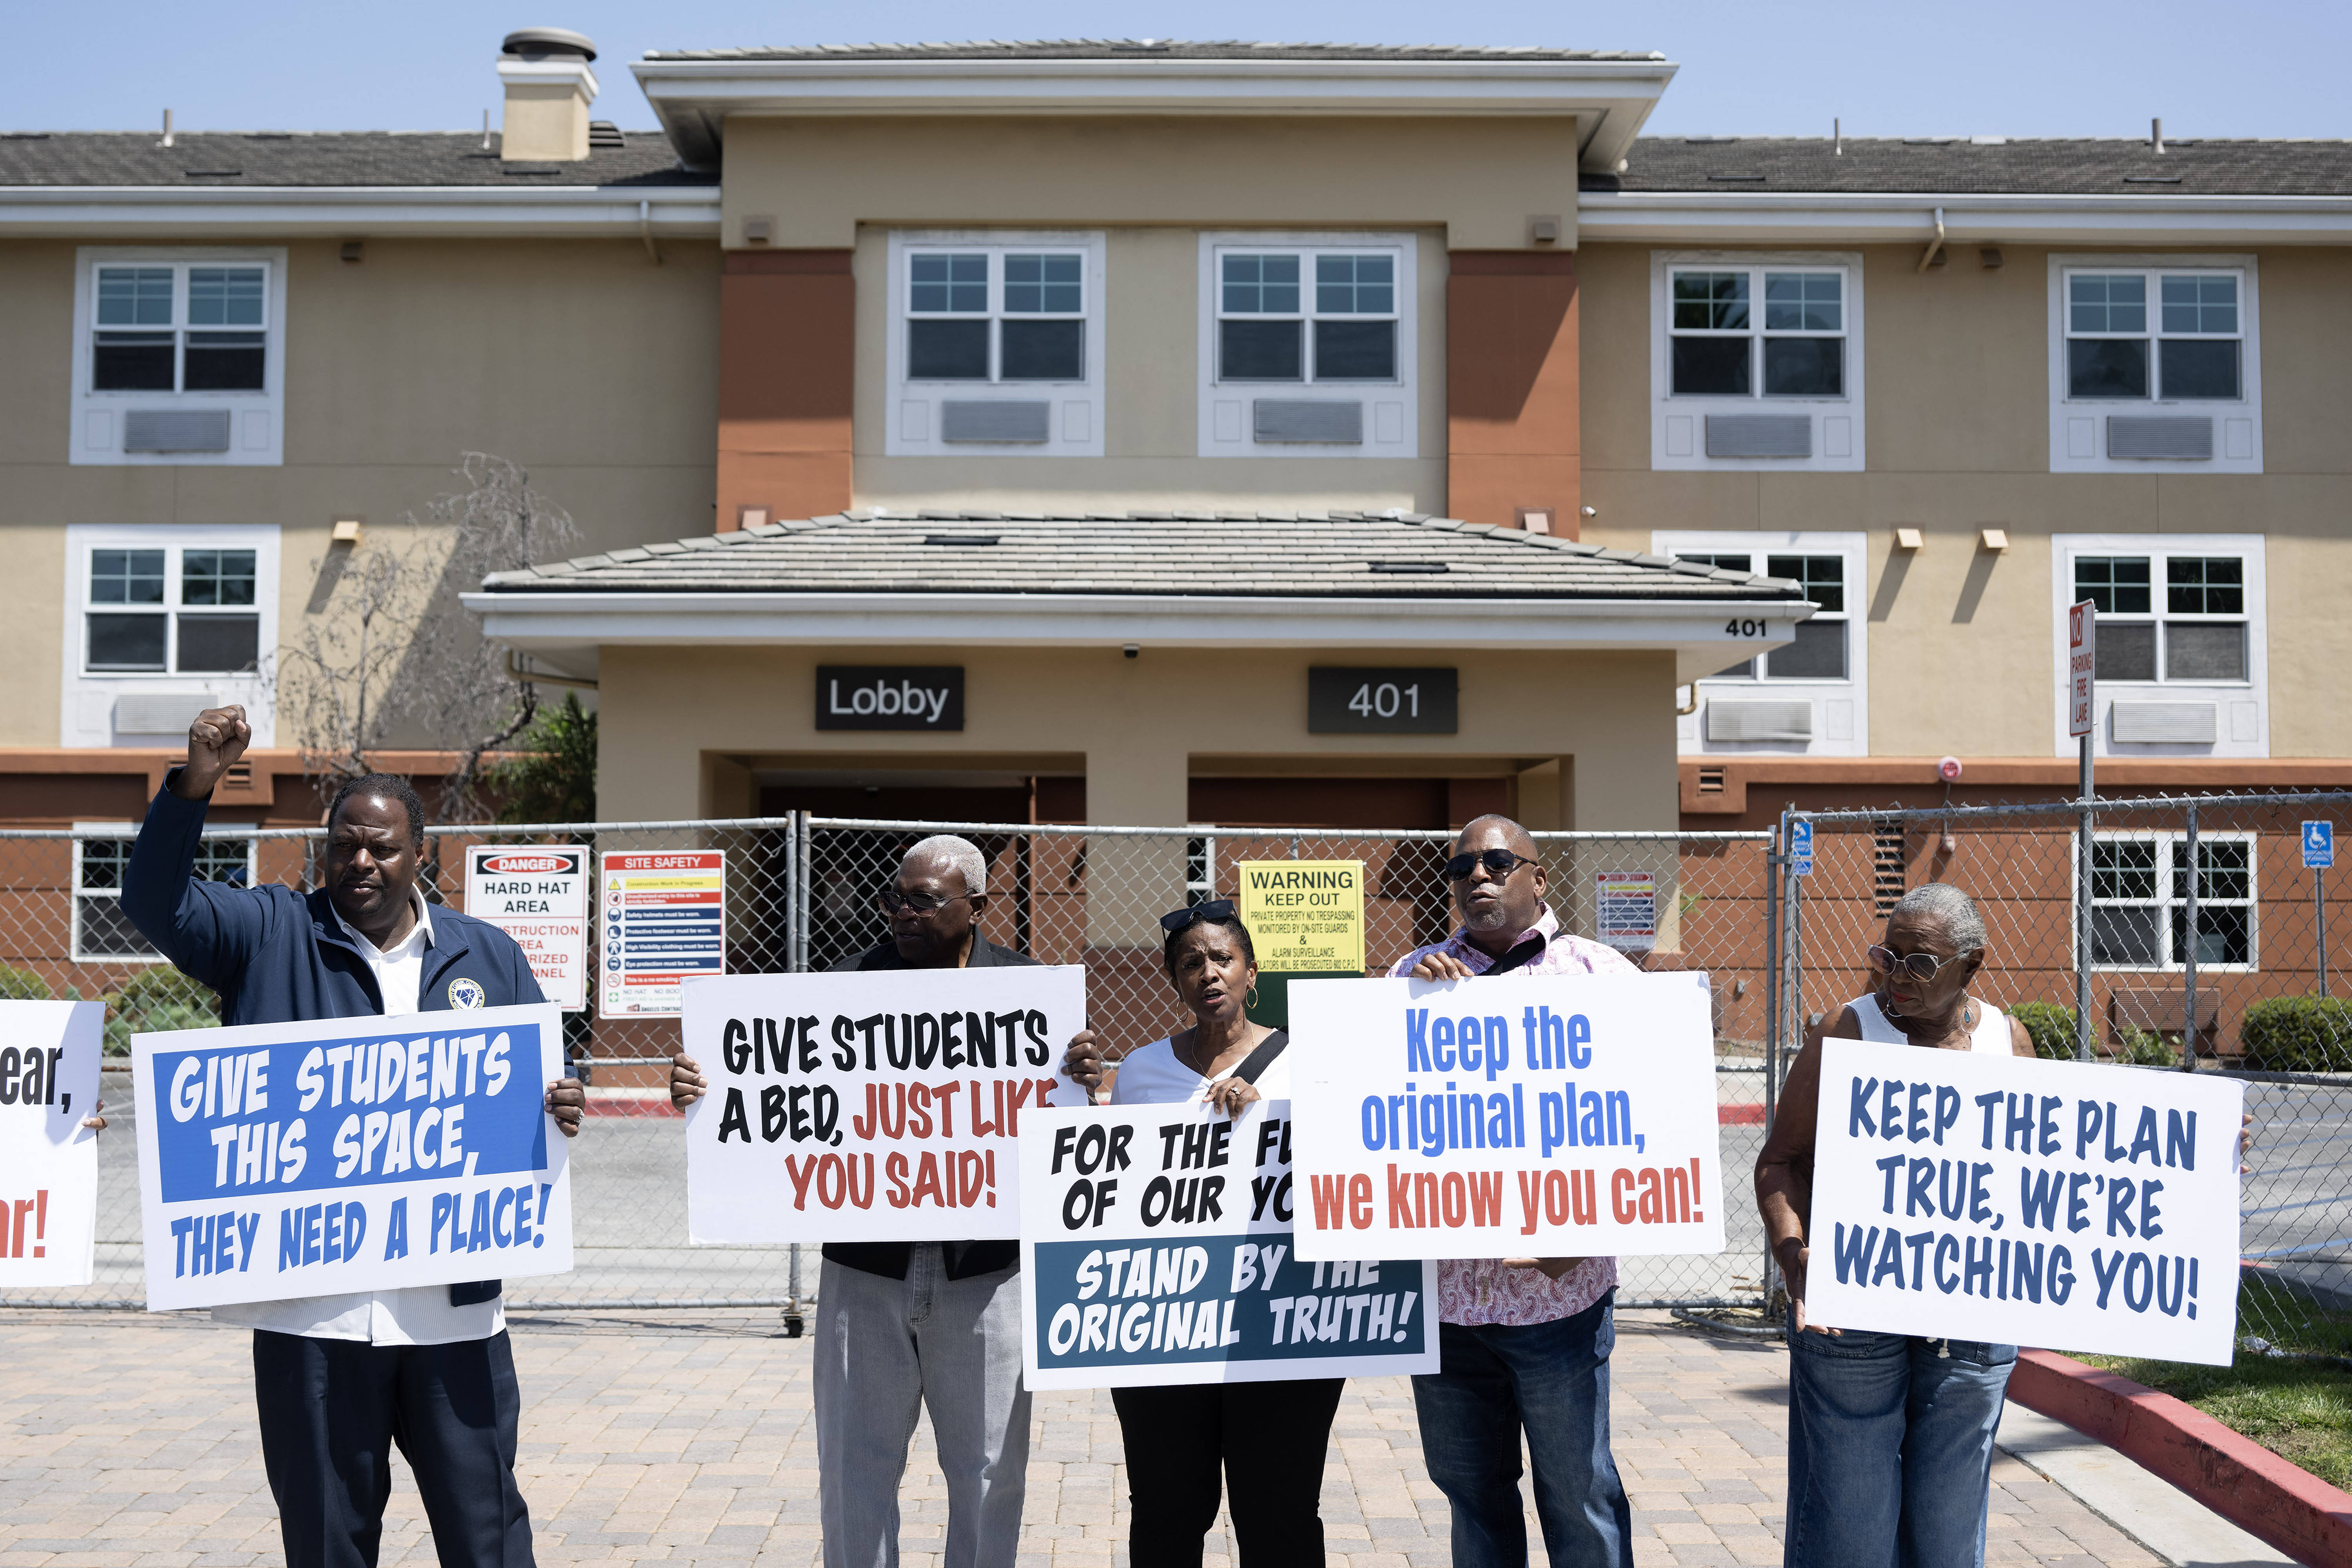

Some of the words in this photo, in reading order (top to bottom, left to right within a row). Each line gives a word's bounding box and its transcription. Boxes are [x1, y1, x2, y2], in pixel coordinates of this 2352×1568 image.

[1726, 619, 1766, 636] 401
[2071, 612, 2082, 643] NO
[2072, 652, 2091, 674] PARKING
[831, 680, 948, 722] Lobby
[1349, 684, 1417, 717] 401
[2077, 677, 2087, 698] FIRE
[2076, 702, 2087, 722] LANE
[499, 858, 557, 871] DANGER
[624, 858, 652, 869] SITE
[654, 857, 701, 868] SAFETY
[485, 882, 532, 895] HARD
[538, 882, 571, 894] HAT
[1250, 871, 1353, 889] WARNING
[504, 900, 550, 913] AREA
[1265, 893, 1304, 906] KEEP
[1310, 893, 1340, 906] OUT
[500, 926, 579, 935] STRUCTION
[1250, 911, 1274, 921] PRIVATE
[1276, 911, 1305, 920] PROPERTY
[1307, 911, 1314, 920] NO
[1316, 911, 1355, 920] TRESPASSING
[1258, 924, 1291, 933] MONITORED
[1292, 924, 1299, 933] BY
[1301, 924, 1322, 933] ON-SITE
[1325, 924, 1348, 933] GUARDS
[517, 940, 543, 949] REA
[1272, 948, 1291, 958] ALARM
[1293, 947, 1335, 958] SURVEILLANCE
[1299, 935, 1307, 945] &
[1280, 960, 1291, 970] WILL
[1293, 960, 1299, 969] BE
[1301, 960, 1332, 969] PROSECUTED
[723, 1015, 822, 1074] GIVE
[831, 1009, 1049, 1071] STUDENTS
[1406, 1009, 1508, 1081] Keep
[1523, 1006, 1591, 1070] the
[171, 1049, 269, 1122] GIVE
[296, 1032, 510, 1111] STUDENTS
[718, 1087, 751, 1143] A
[761, 1084, 843, 1147] BED,
[853, 1080, 960, 1140] JUST
[1362, 1082, 1525, 1157] original
[1539, 1082, 1644, 1158] plan,
[1849, 1076, 1960, 1146] KEEP
[1975, 1091, 2062, 1157] THE
[2076, 1100, 2197, 1171] PLAN
[211, 1118, 307, 1187] THIS
[333, 1103, 479, 1178] SPACE,
[1051, 1124, 1133, 1175] FOR
[1160, 1120, 1231, 1171] THE
[785, 1153, 874, 1211] YOU
[886, 1150, 995, 1209] SAID!
[1310, 1174, 1373, 1230] we
[1387, 1163, 1503, 1228] know
[1517, 1170, 1597, 1235] you
[1612, 1158, 1703, 1224] can!
[1063, 1179, 1117, 1230] OF
[1141, 1176, 1225, 1227] OUR
[1876, 1154, 2004, 1230] TRUE,
[2021, 1167, 2164, 1241] WE'RE
[171, 1211, 260, 1278] THEY
[279, 1201, 366, 1273] NEED
[384, 1197, 408, 1261] A
[430, 1183, 552, 1255] PLACE!
[1076, 1246, 1208, 1299] STAND
[1230, 1243, 1287, 1293] BY
[1835, 1222, 2076, 1305] WATCHING
[2091, 1248, 2198, 1320] YOU!
[1048, 1299, 1240, 1356] ORIGINAL
[1270, 1291, 1417, 1345] TRUTH!
